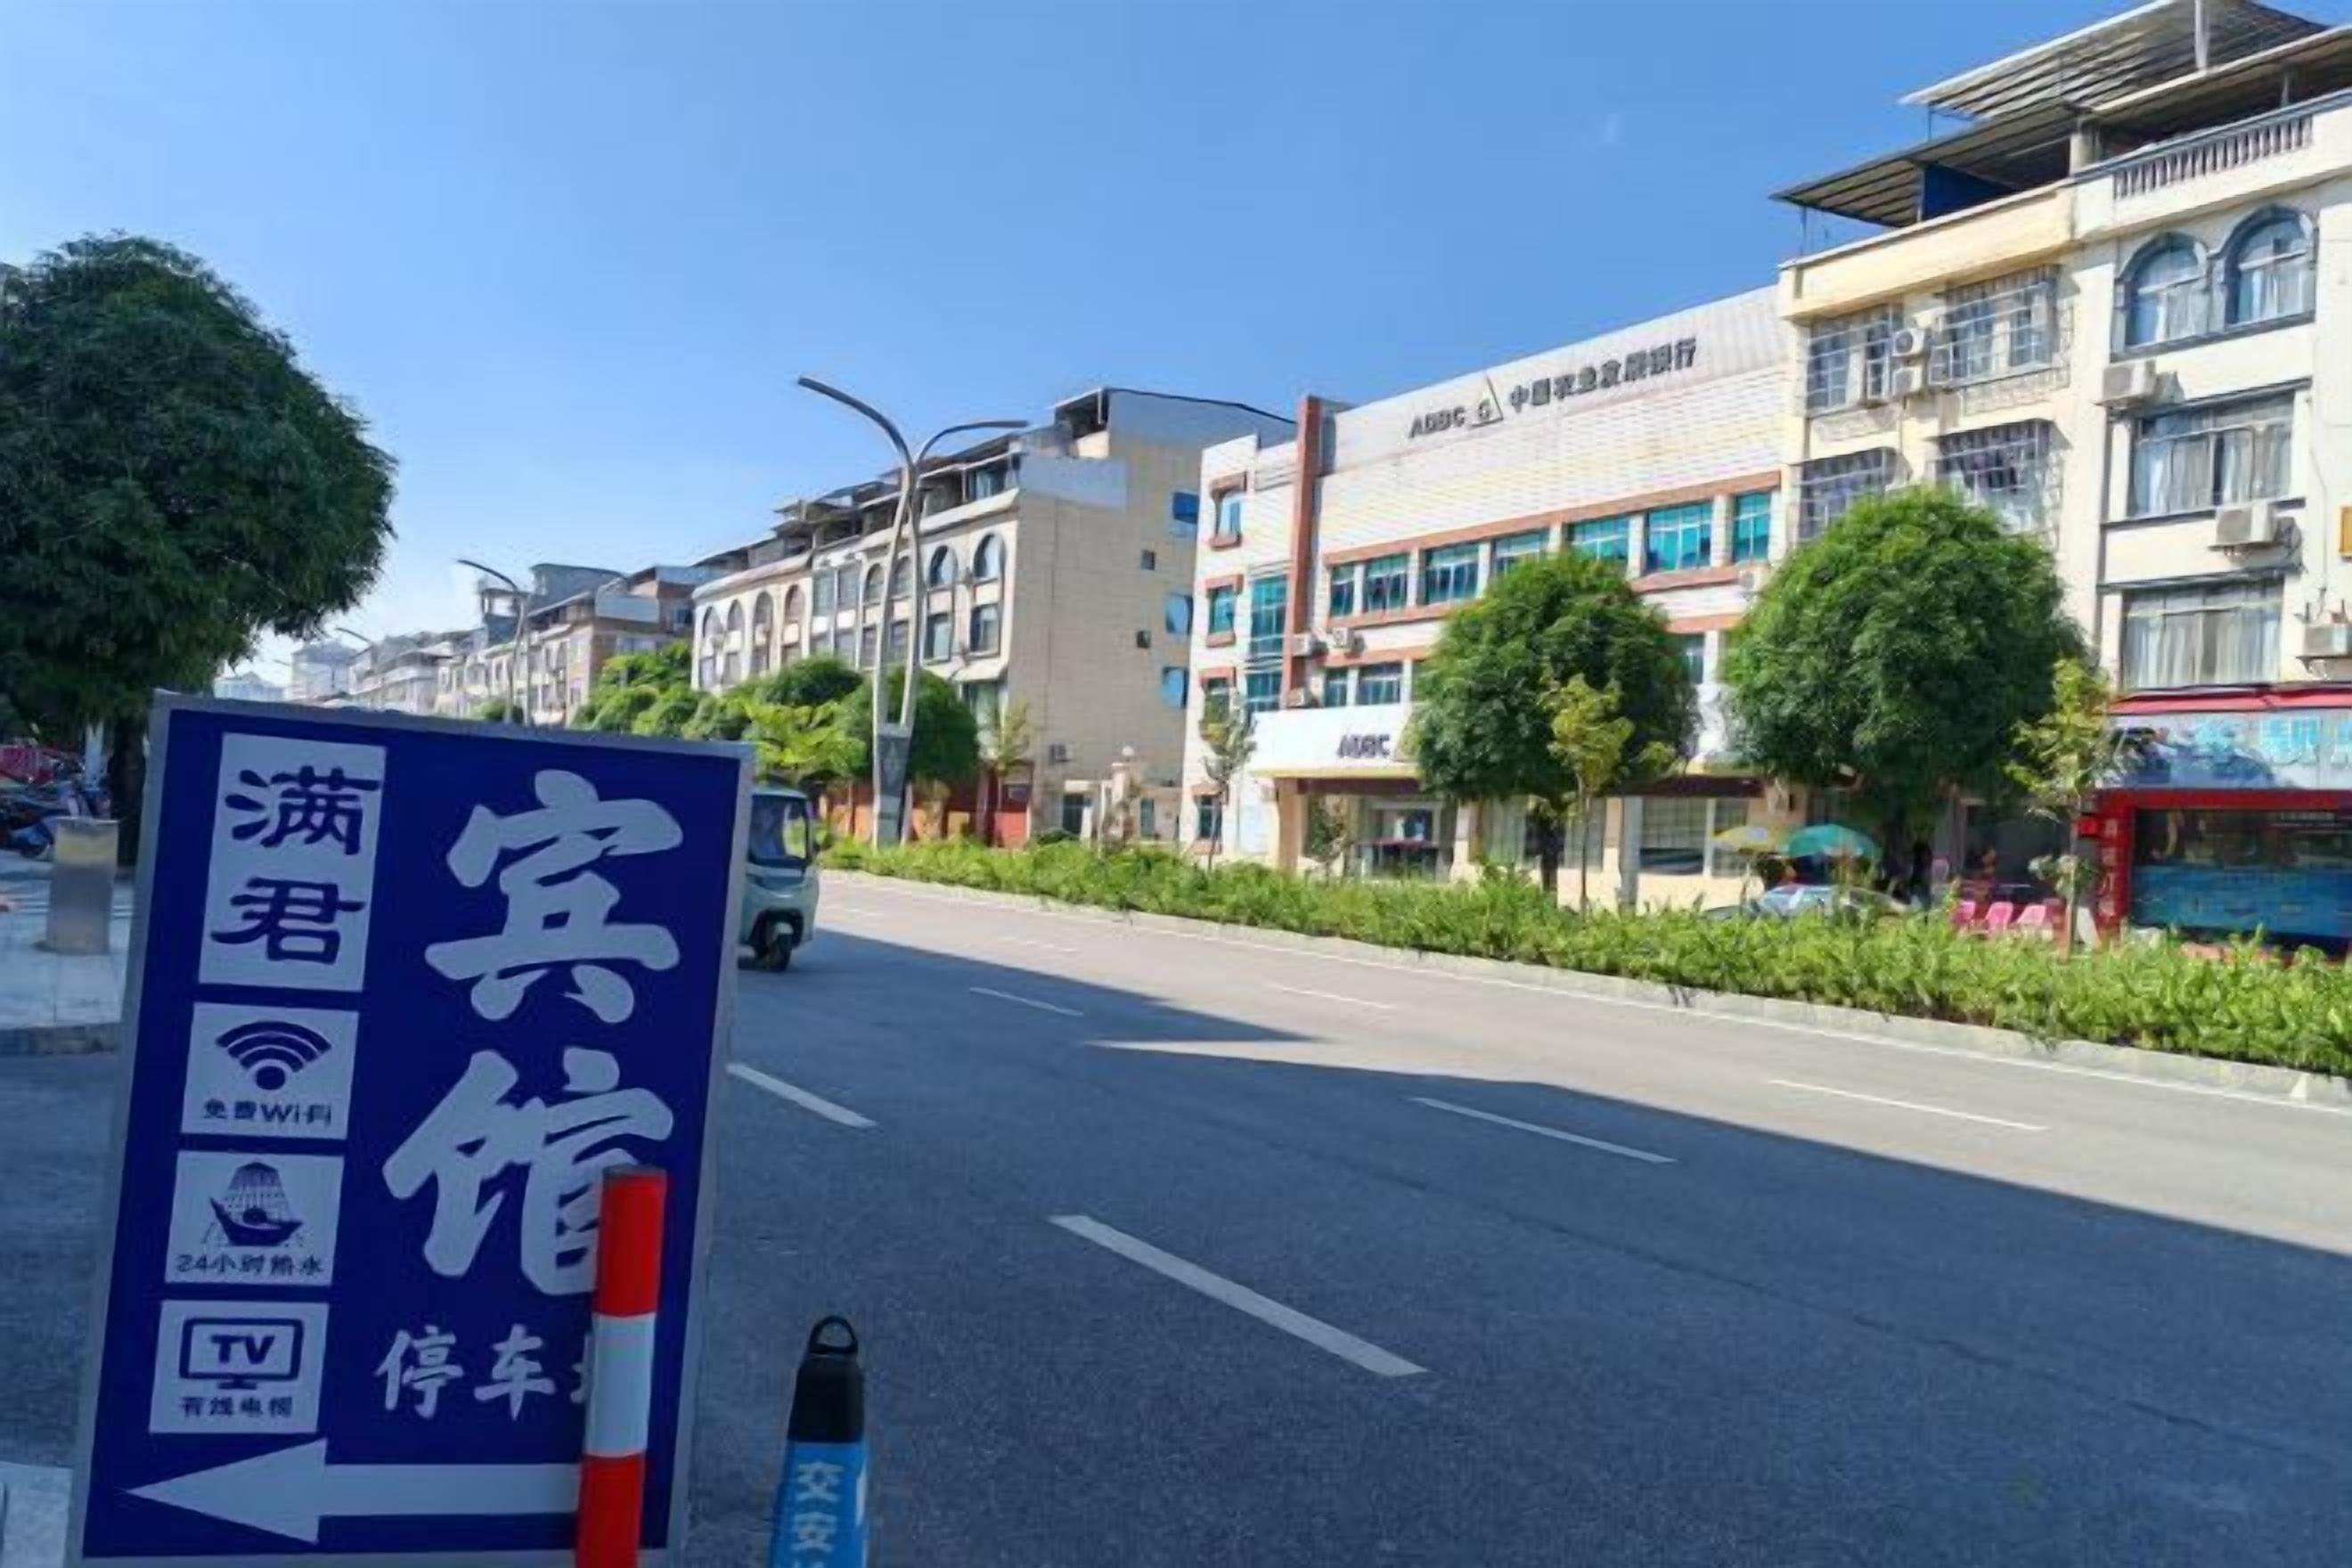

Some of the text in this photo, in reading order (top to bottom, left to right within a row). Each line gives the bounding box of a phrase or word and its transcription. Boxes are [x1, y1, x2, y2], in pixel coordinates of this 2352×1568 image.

[210, 765, 380, 966] 满君
[382, 769, 683, 1295] 宾馆
[210, 1334, 275, 1364] TV
[373, 1324, 592, 1421] 停车
[788, 1461, 845, 1568] 交安
